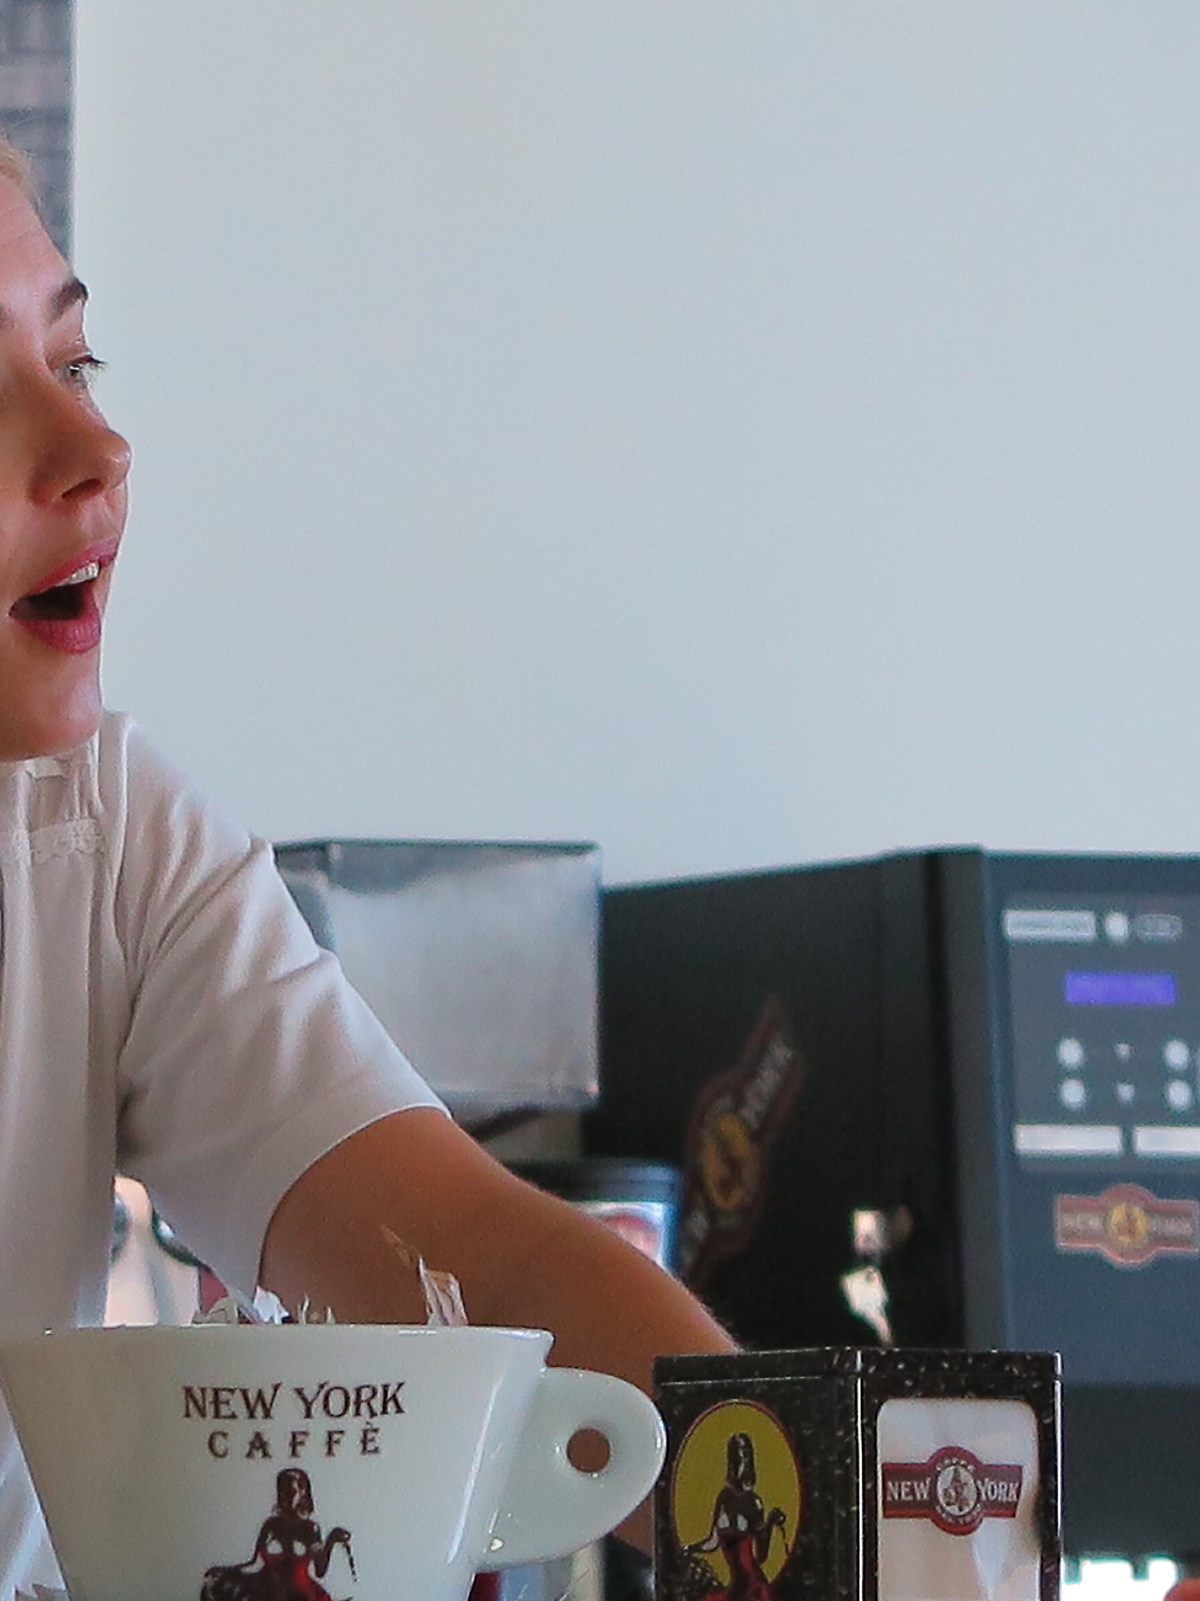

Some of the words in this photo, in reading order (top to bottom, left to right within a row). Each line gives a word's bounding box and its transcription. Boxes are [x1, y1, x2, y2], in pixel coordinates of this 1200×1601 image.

[182, 1382, 282, 1420] NEW
[293, 1380, 406, 1419] YORK
[206, 1421, 382, 1460] CAFFÈ
[886, 1477, 932, 1502] NEW
[975, 1477, 1020, 1503] YORK
